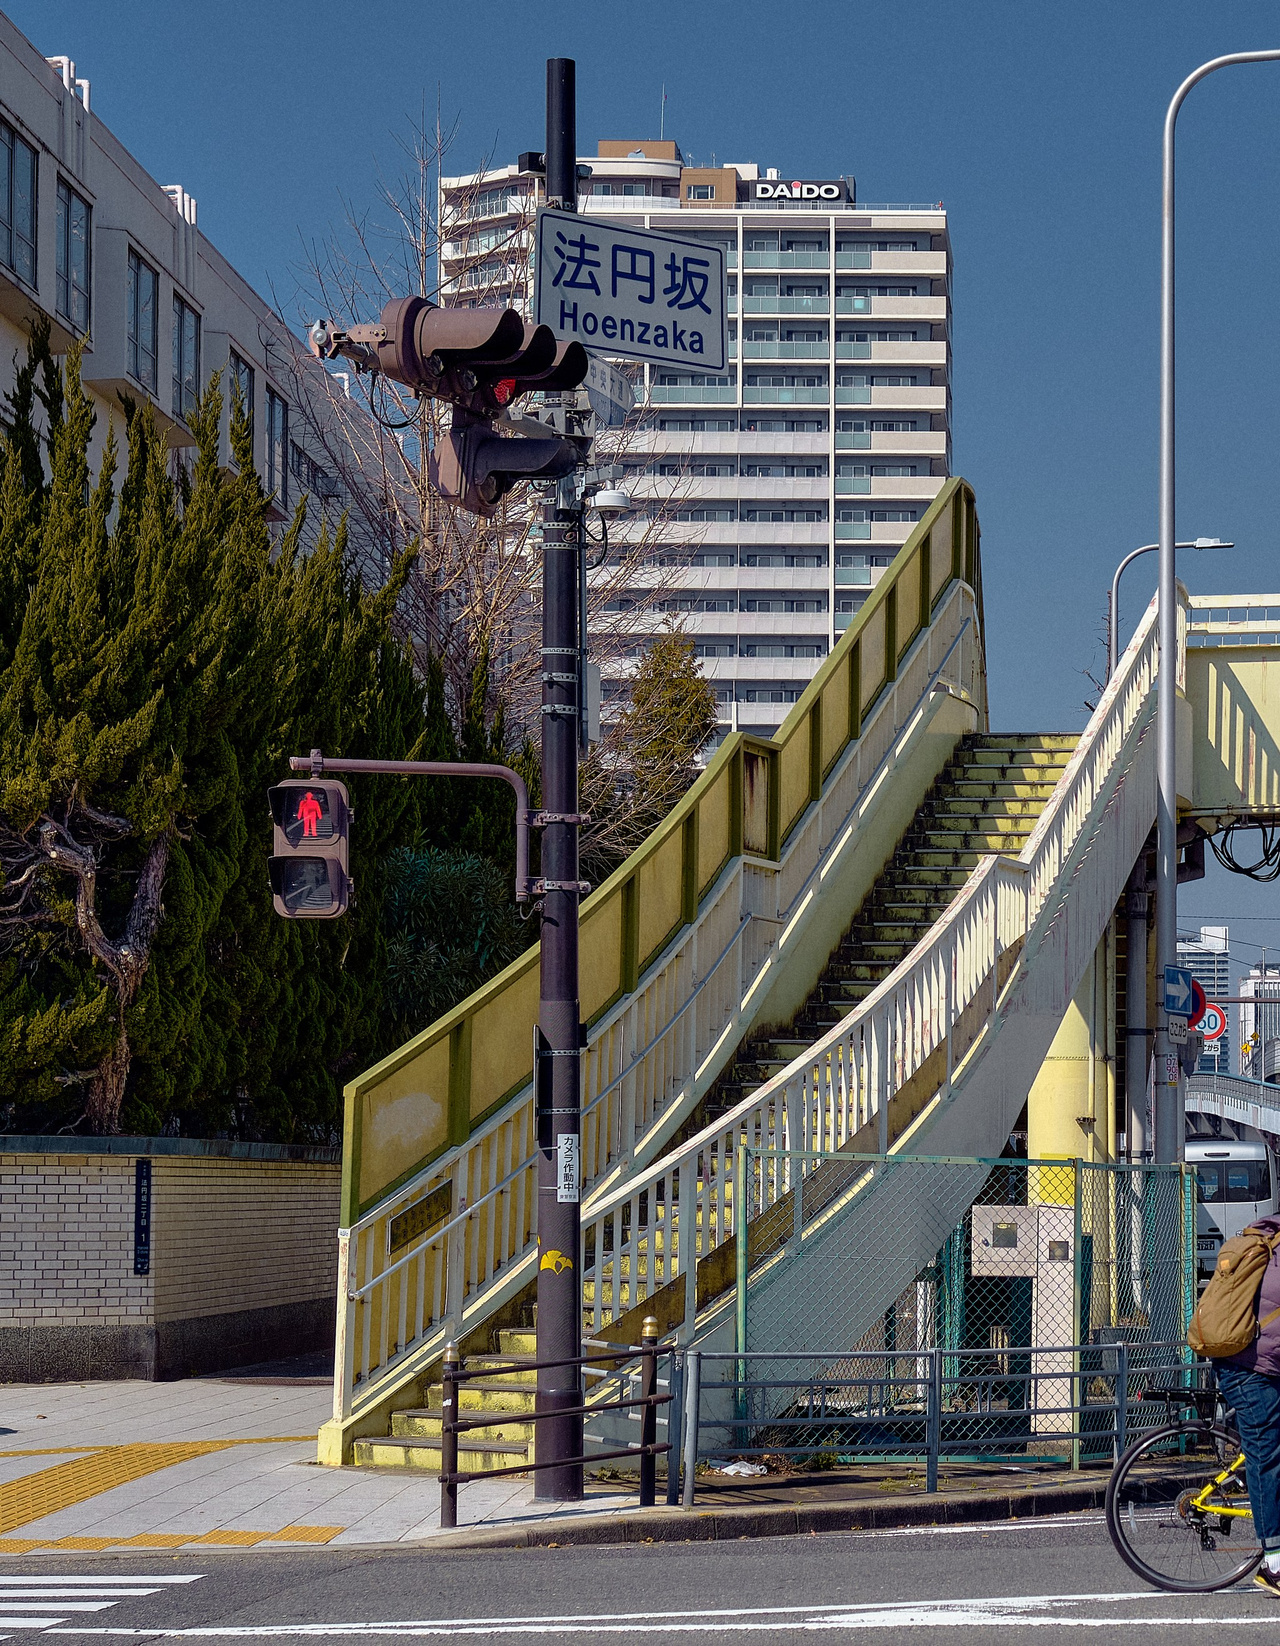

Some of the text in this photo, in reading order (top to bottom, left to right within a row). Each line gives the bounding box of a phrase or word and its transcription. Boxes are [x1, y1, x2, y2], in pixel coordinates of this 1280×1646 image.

[552, 231, 711, 315] 法円坂
[560, 300, 704, 354] Hoenzaka
[1170, 1022, 1187, 1037] ここから
[563, 1137, 574, 1192] カメラ作動中
